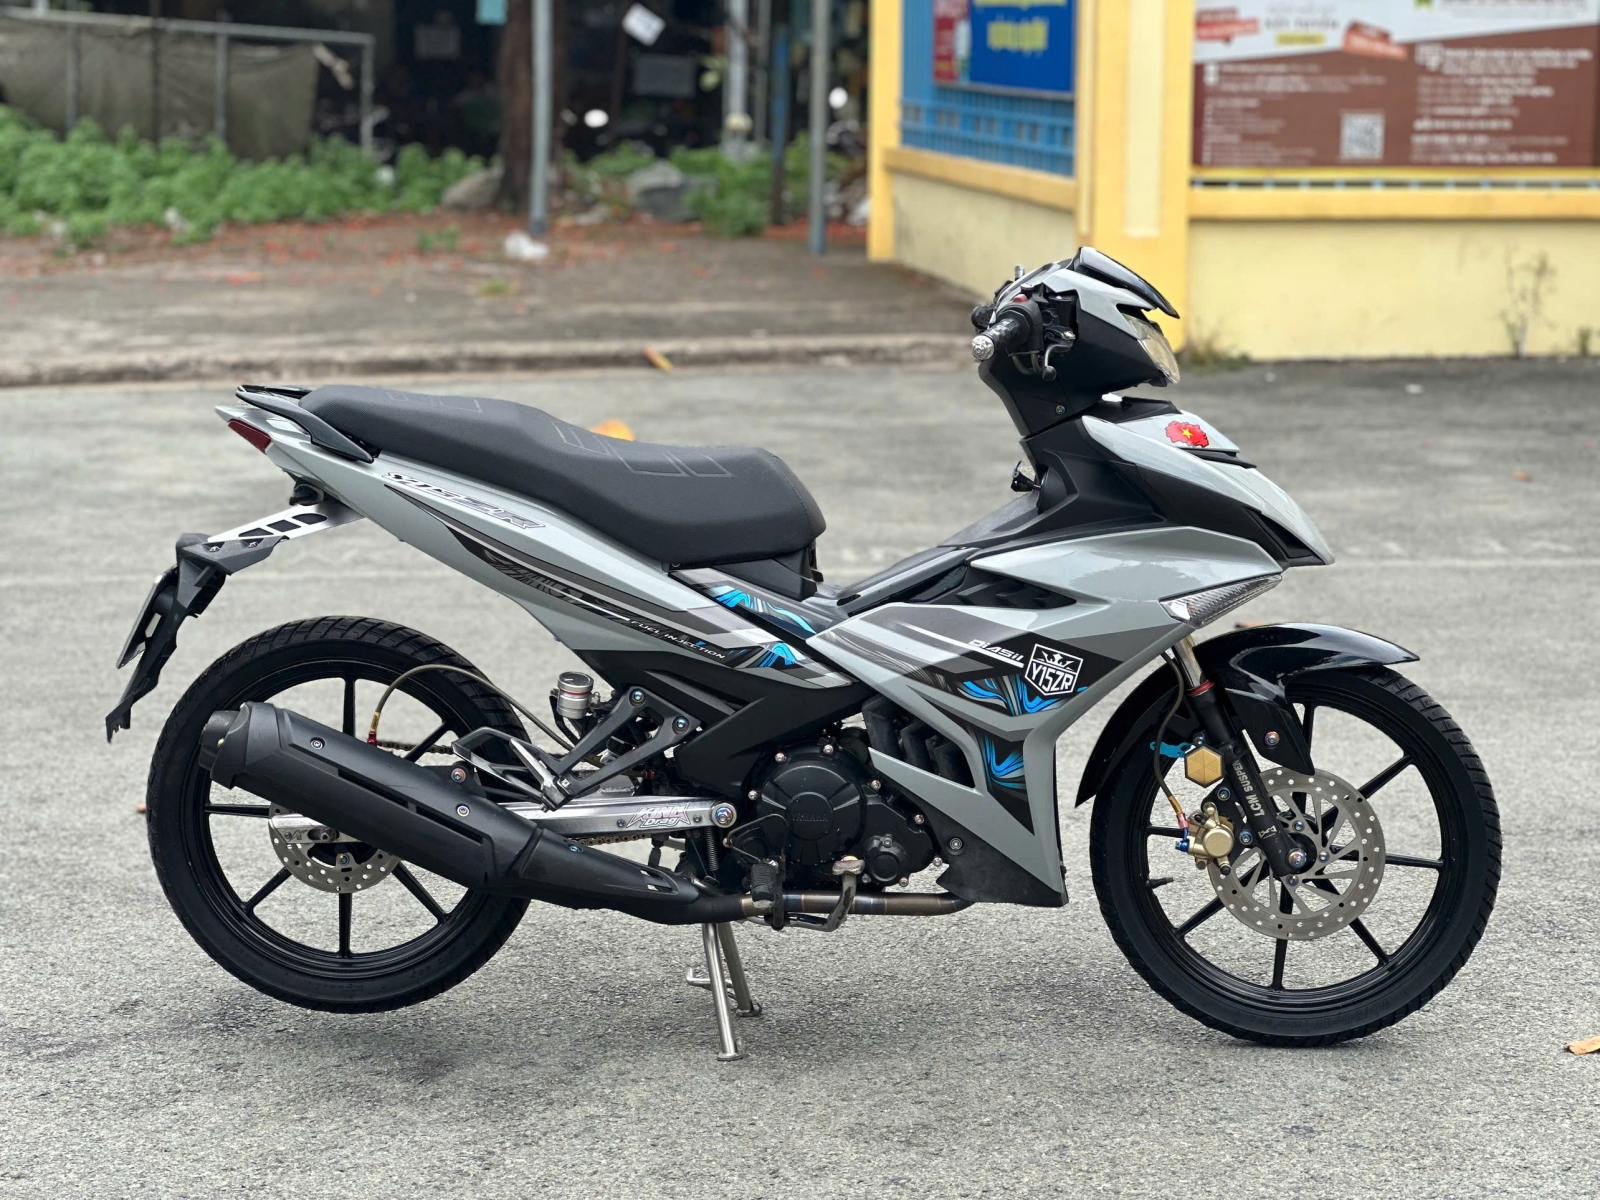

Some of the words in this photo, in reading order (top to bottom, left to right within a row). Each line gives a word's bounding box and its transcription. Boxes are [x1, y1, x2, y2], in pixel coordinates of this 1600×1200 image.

[631, 620, 660, 635] FUEL
[664, 633, 726, 660] INJECTION
[1031, 662, 1074, 692] Y15ZR
[1245, 793, 1265, 817] LCM
[643, 817, 677, 827] Drag
